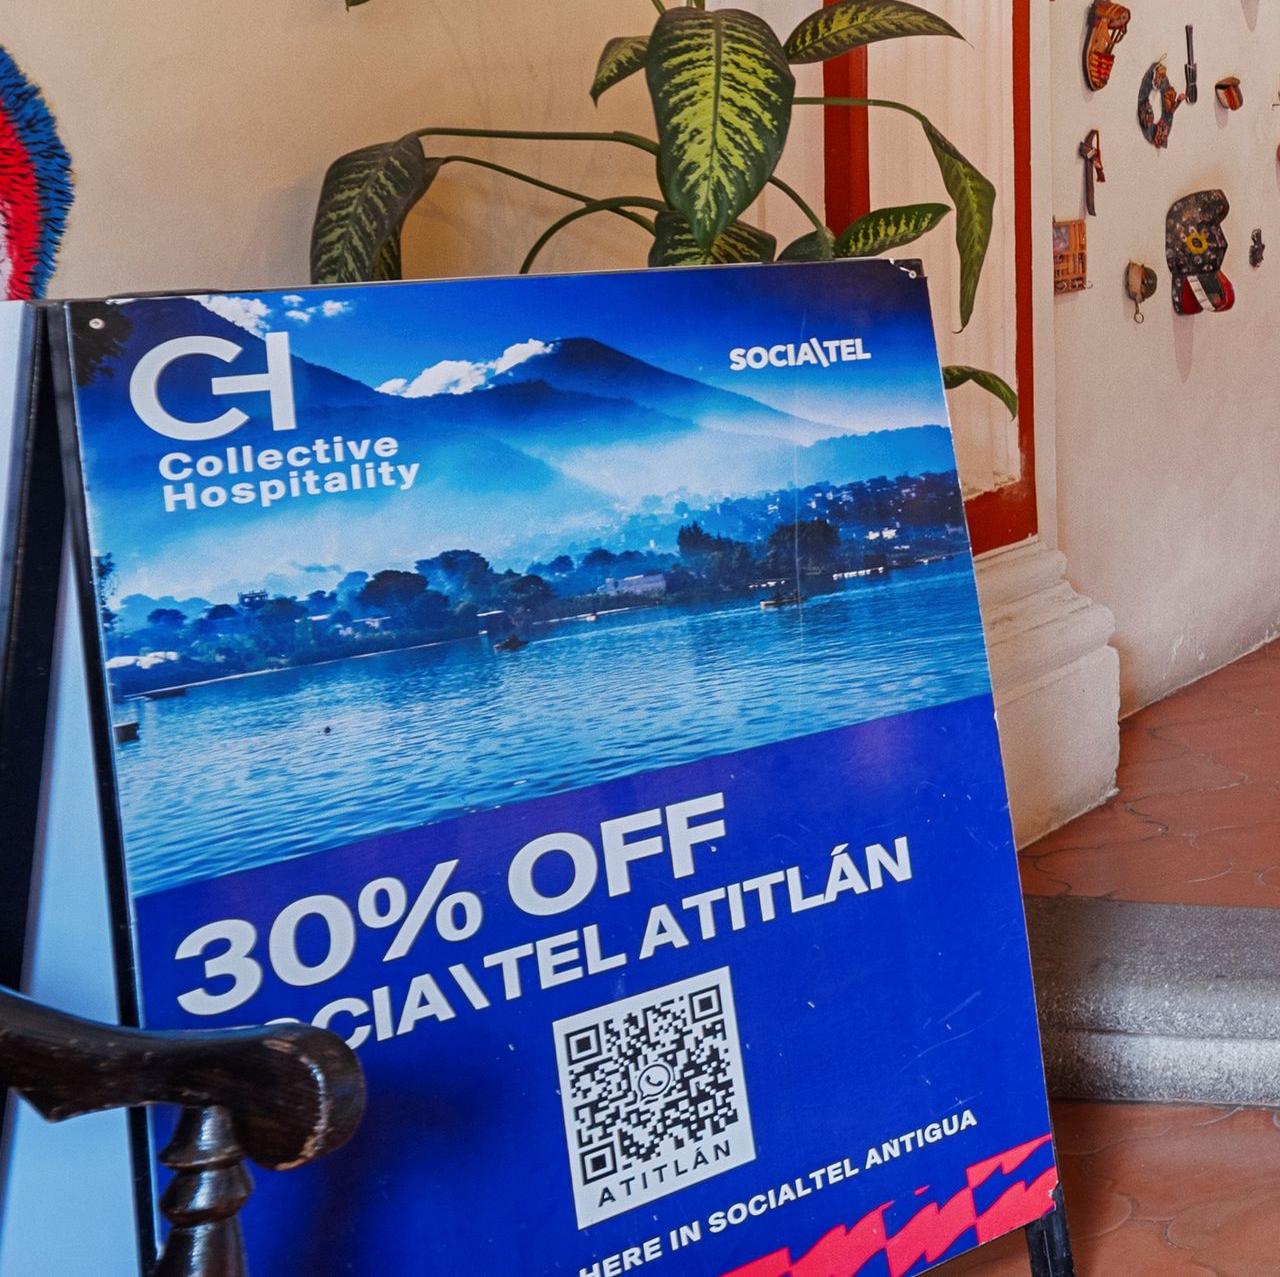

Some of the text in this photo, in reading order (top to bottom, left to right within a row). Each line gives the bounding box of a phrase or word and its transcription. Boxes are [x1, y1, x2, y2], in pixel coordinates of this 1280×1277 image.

[158, 435, 400, 482] Collective
[162, 460, 421, 513] Hospitality
[174, 792, 727, 1017] 30% OFF
[638, 836, 912, 960] ATITLÁN
[579, 1109, 977, 1277] HERE IN SOCIALTEL ANTIGUA
[597, 1139, 731, 1207] ATITLÁN
